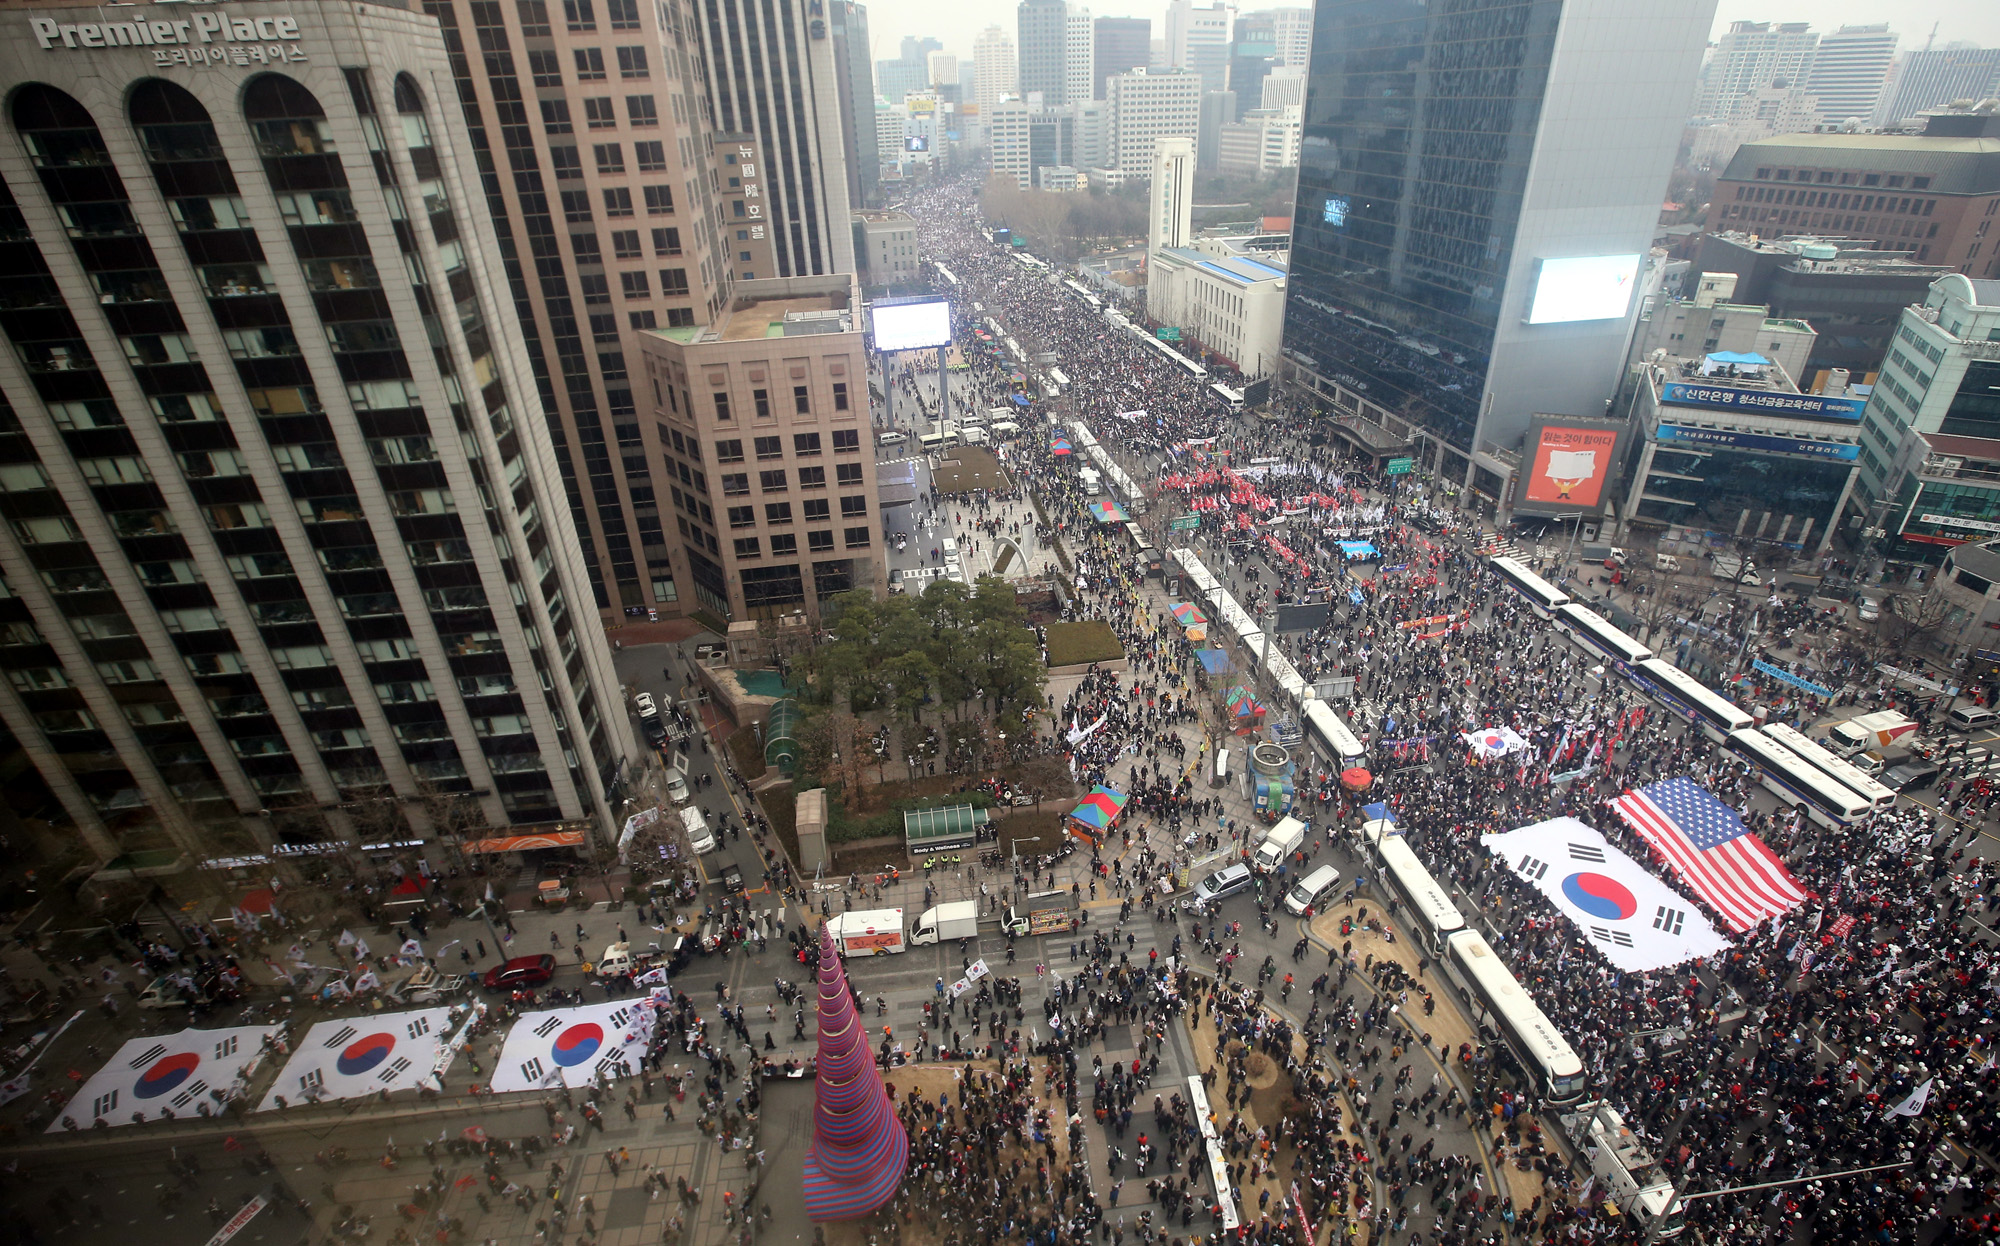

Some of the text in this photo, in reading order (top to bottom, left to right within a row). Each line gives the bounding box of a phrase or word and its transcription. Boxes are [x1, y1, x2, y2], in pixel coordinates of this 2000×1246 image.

[29, 11, 301, 49] Premier Place
[151, 44, 308, 67] 프리미어플레이스
[1686, 389, 1734, 403] 신한은행
[1739, 394, 1823, 411] 청소년금융교육센터
[1544, 432, 1612, 446] 읽는 것이 힘이다
[1812, 802, 1827, 815] POLICE
